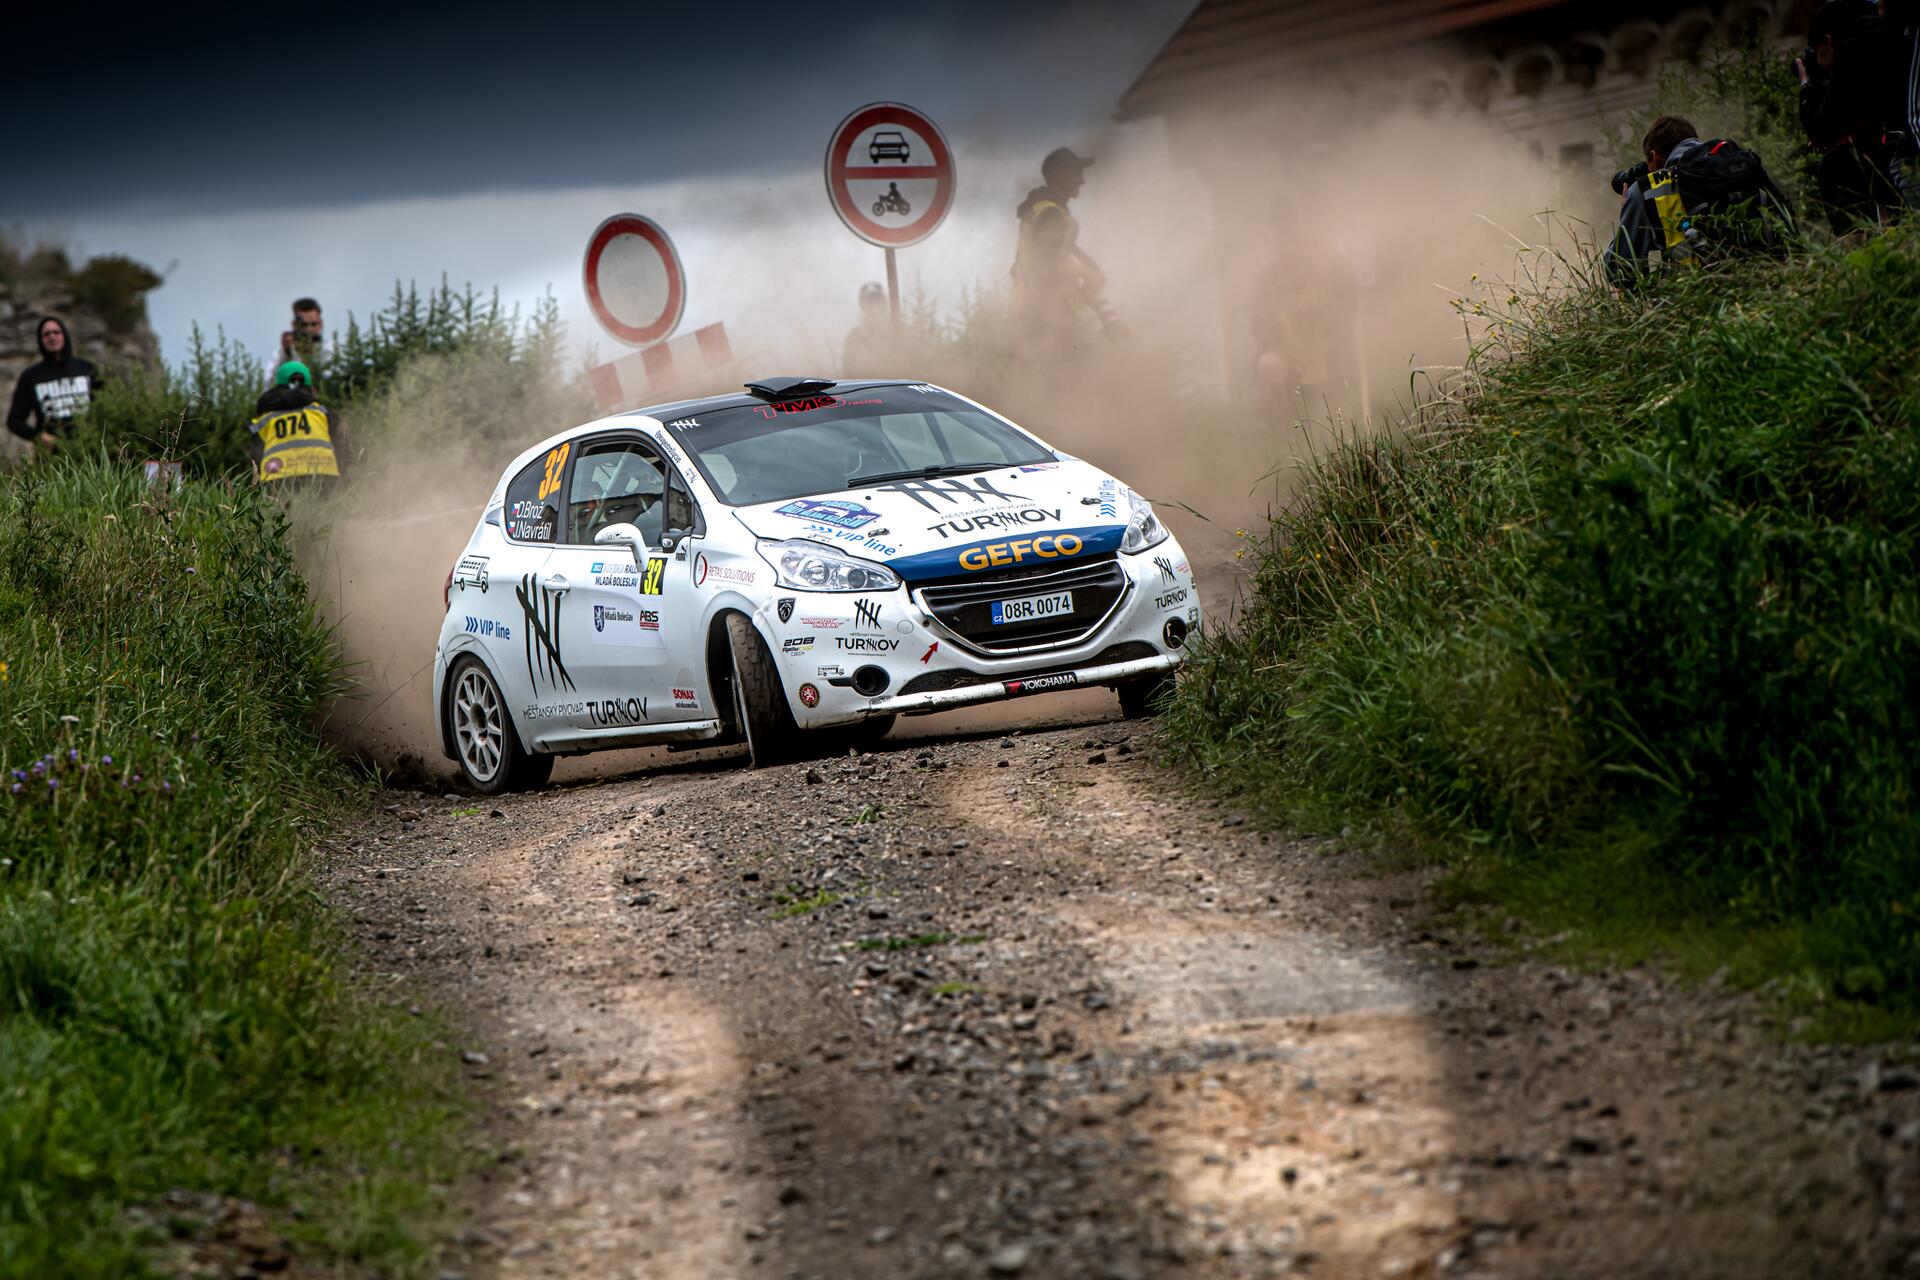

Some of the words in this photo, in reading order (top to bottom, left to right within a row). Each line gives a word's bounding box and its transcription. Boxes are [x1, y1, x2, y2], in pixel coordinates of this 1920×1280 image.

[848, 398, 883, 406] racing
[275, 412, 311, 439] 074
[538, 442, 571, 500] 32
[516, 500, 545, 519] D.Brož
[513, 520, 552, 540] J.Navrátil
[835, 530, 864, 542] VIP
[863, 538, 897, 556] line
[958, 533, 1083, 571] GEFCO
[624, 564, 639, 574] RALL
[643, 558, 663, 595] 32
[708, 565, 722, 578] RETAIL
[723, 567, 756, 583] SOLUTIONS
[595, 574, 612, 586] MLADÁ
[612, 576, 639, 587] BOLESLAV
[1004, 601, 1033, 619] 08R
[1036, 595, 1070, 615] 0074
[639, 610, 659, 623] ABS
[993, 615, 1003, 623] CZ
[480, 618, 494, 636] VIP
[495, 621, 510, 640] line
[784, 636, 816, 647] 208
[1022, 674, 1076, 690] YOKOHAMA
[672, 688, 696, 700] SONAX
[558, 702, 584, 716] PIVOVAR
